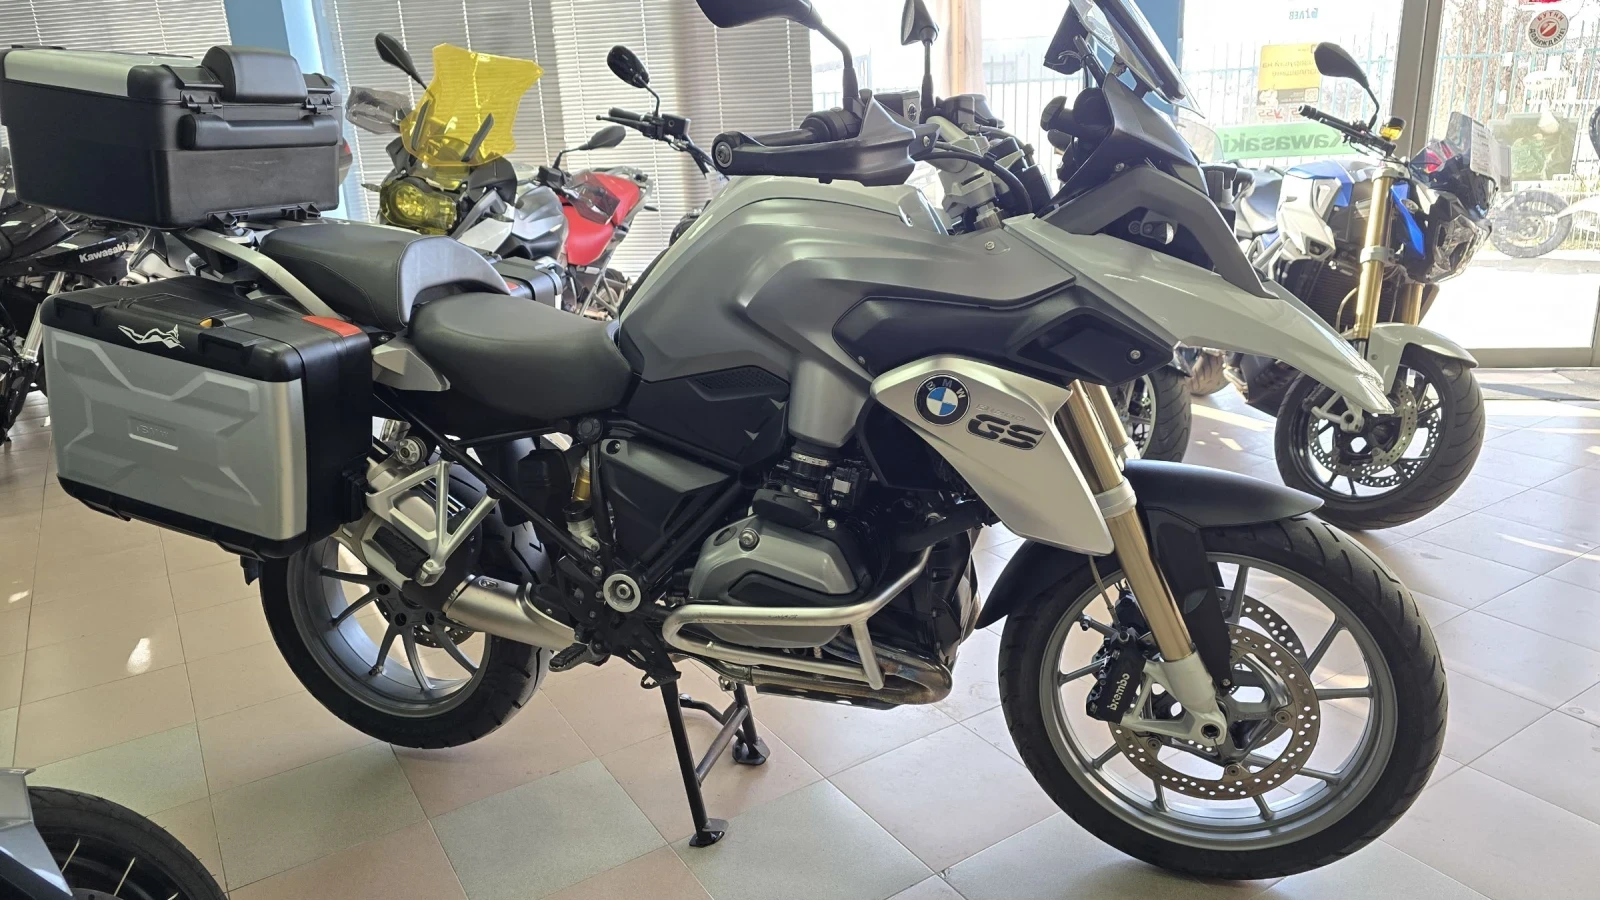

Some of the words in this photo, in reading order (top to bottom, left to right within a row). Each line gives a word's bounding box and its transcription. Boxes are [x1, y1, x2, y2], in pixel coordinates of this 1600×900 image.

[1537, 12, 1564, 21] БУТНИ
[79, 242, 127, 263] Kawasaki
[925, 378, 967, 400] BMW
[966, 413, 1046, 450] GS
[1106, 673, 1131, 711] brembo
